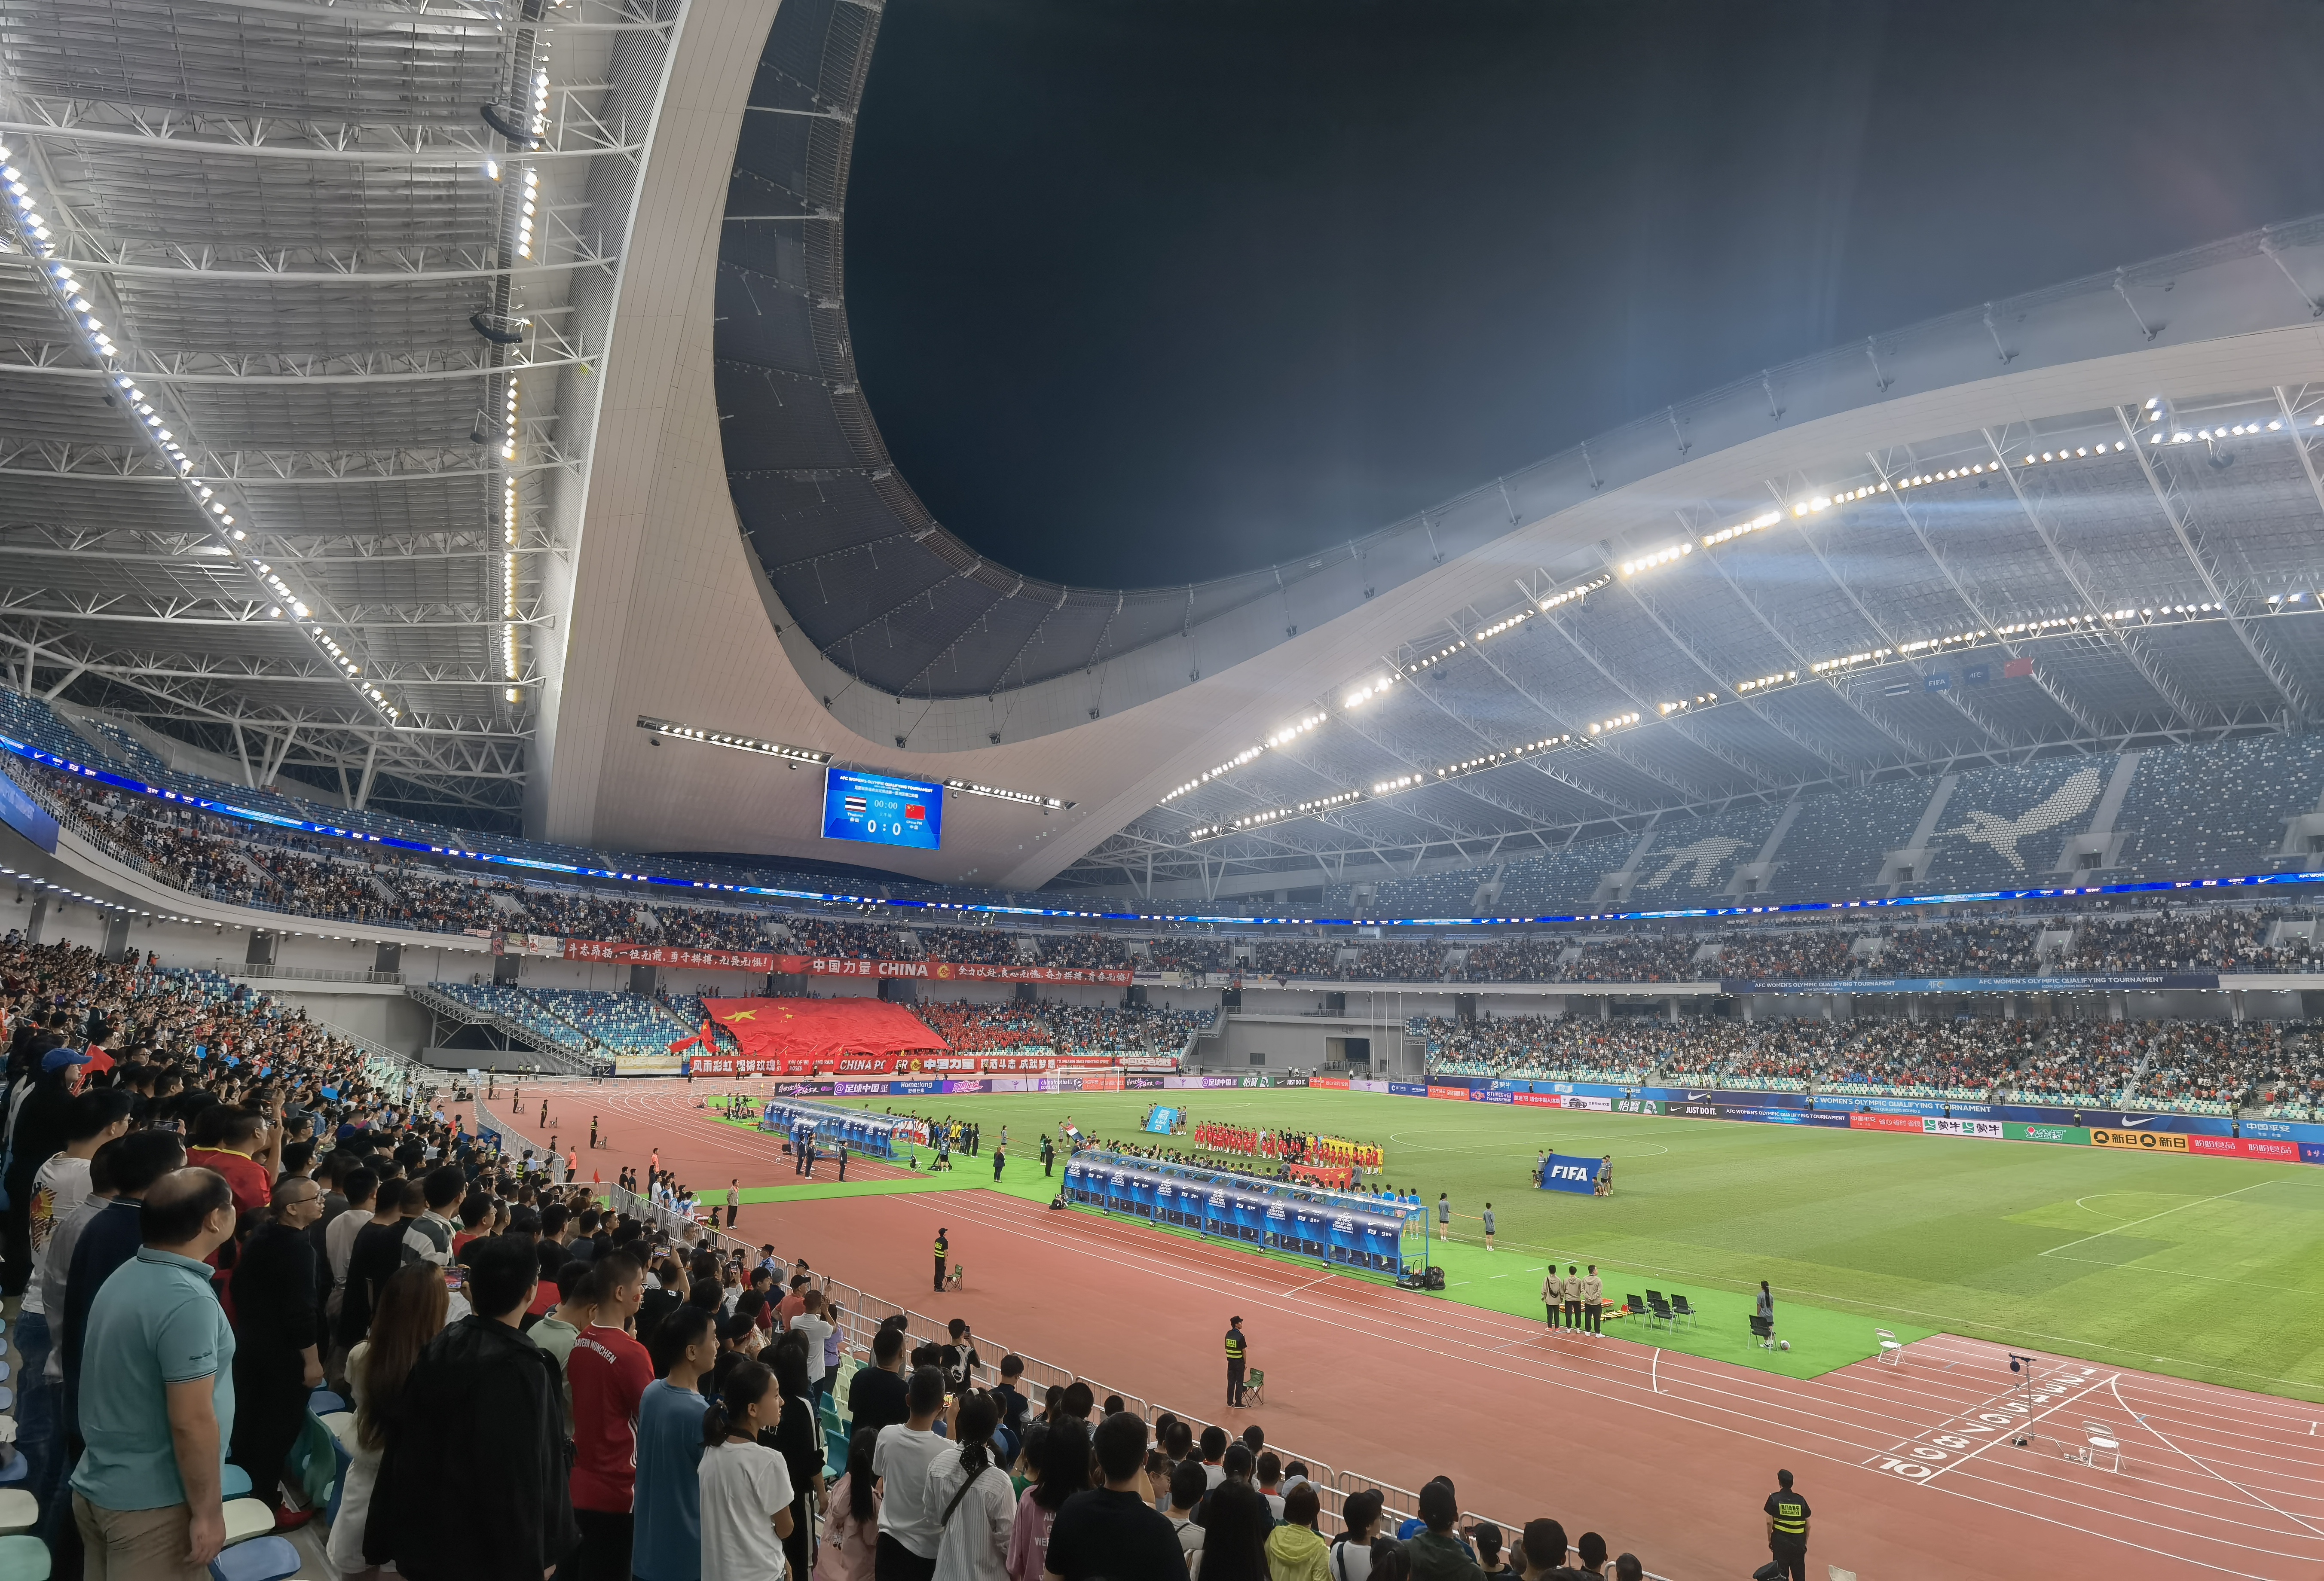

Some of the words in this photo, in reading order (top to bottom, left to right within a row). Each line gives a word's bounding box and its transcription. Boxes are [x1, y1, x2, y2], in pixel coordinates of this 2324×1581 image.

[874, 800, 898, 810] 00:00
[813, 959, 871, 975] 中国力量
[879, 962, 928, 977] CHINA
[1926, 980, 1944, 989] AFC
[693, 1060, 732, 1072] 风雨彩虹
[840, 1059, 872, 1070] CHINA
[874, 1060, 907, 1070] POER
[924, 1059, 974, 1070] 中国力量
[1119, 1057, 1171, 1066] 中国女足必胜
[1888, 1101, 1933, 1109] QUALIFYING
[1935, 1103, 1991, 1113] TORNAMENT
[1938, 1121, 1960, 1132] 蒙牛
[1976, 1123, 1999, 1135] 蒙牛
[2247, 1123, 2290, 1132] 中国平安
[2112, 1133, 2137, 1145] 新日
[2159, 1137, 2186, 1148] 新日
[1551, 1166, 1587, 1181] FIFA
[2080, 1367, 2097, 1376] 1
[2052, 1374, 2085, 1386] 2
[2035, 1383, 2068, 1393] 3
[2018, 1394, 2050, 1403] 4
[1998, 1402, 2030, 1413] 5
[1979, 1413, 2013, 1424] 6
[1957, 1422, 1996, 1433] 7
[1933, 1435, 1970, 1448] 8
[1913, 1447, 1948, 1460] 9
[1879, 1457, 1932, 1478] 10
